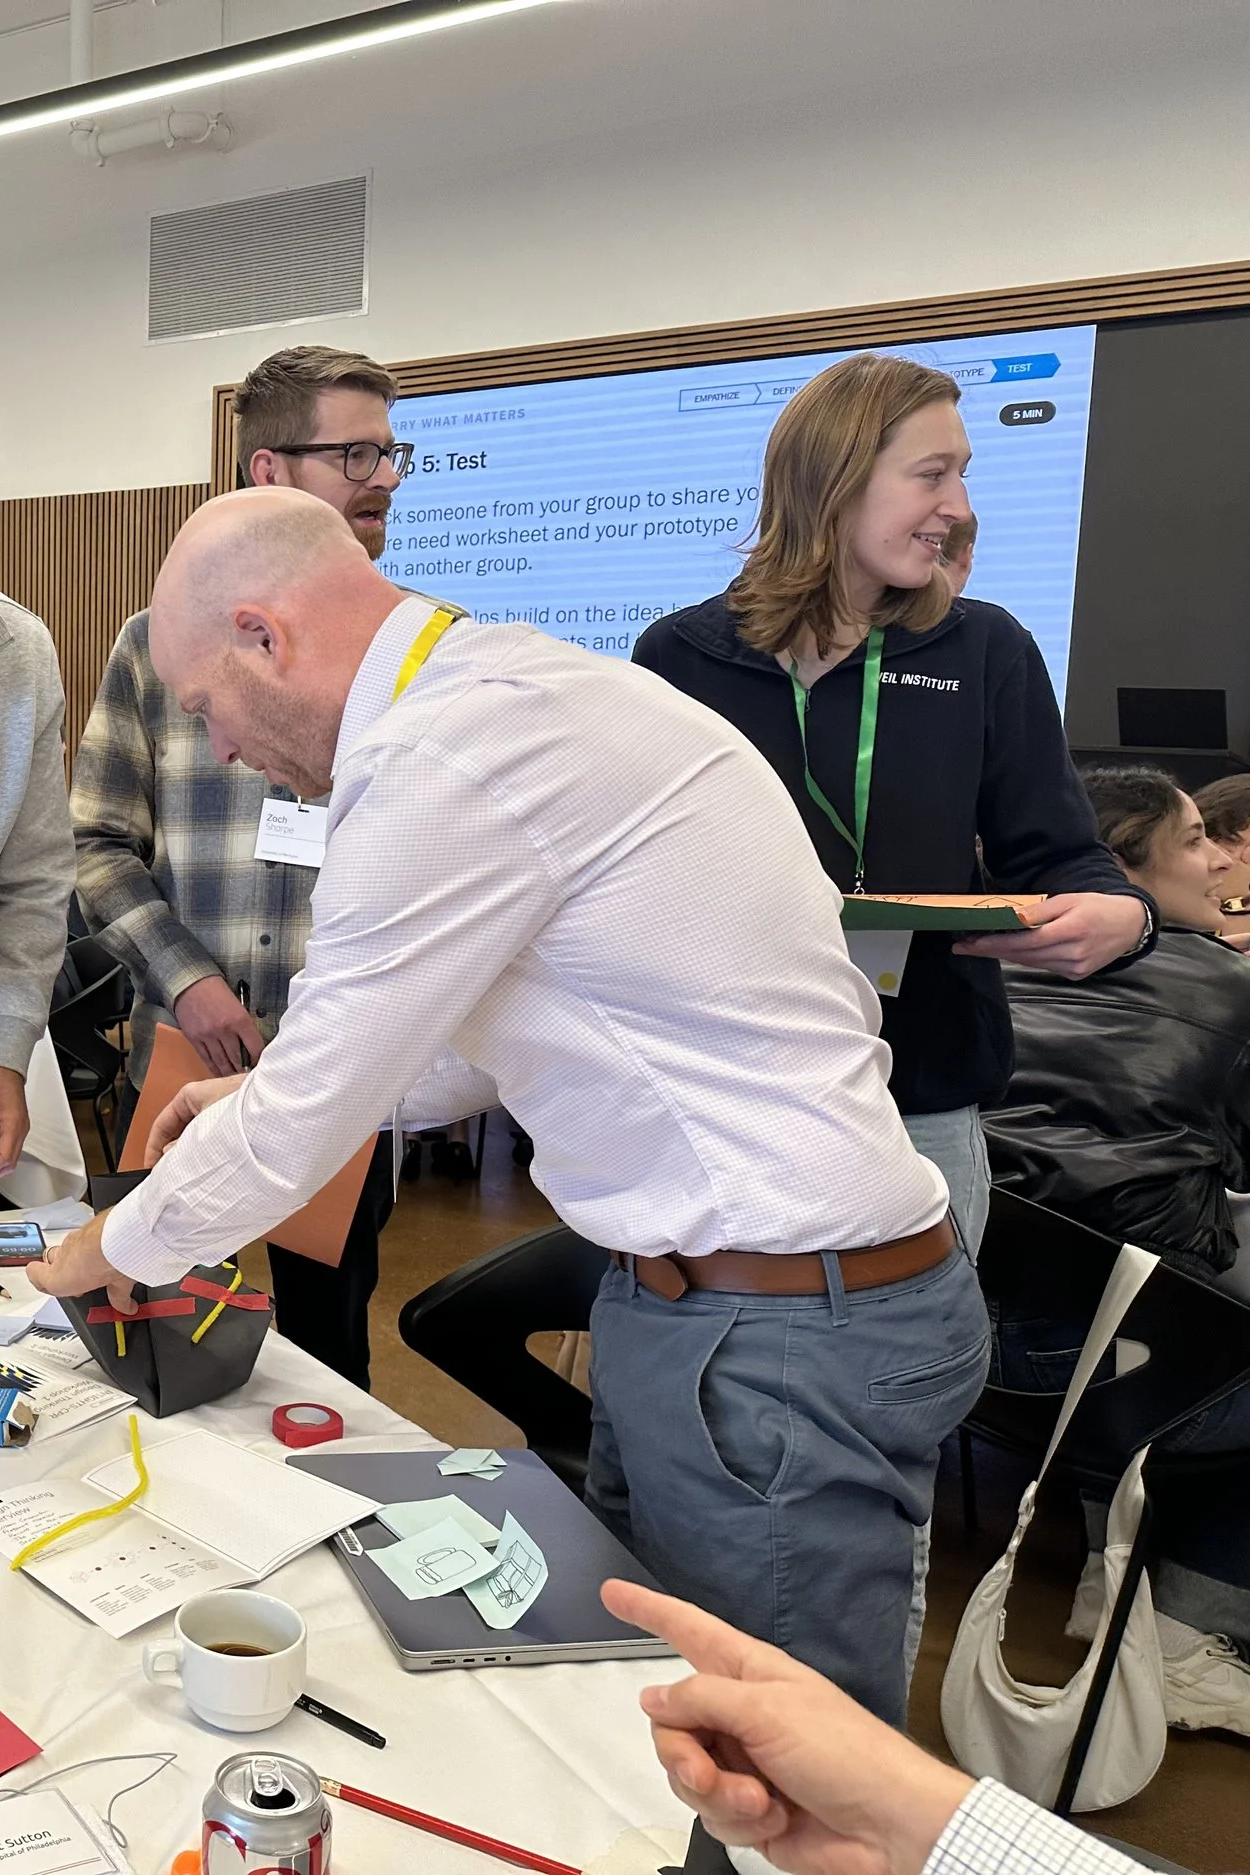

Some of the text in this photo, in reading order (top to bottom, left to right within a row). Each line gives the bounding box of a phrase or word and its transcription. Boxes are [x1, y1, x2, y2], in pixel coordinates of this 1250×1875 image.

[694, 391, 740, 403] EMPATHIZE
[1007, 363, 1033, 374] TEST
[392, 408, 526, 432] RRY WHAT MATTERS
[1012, 408, 1043, 420] 5 MIN
[422, 455, 441, 473] 5:
[446, 451, 488, 471] Test
[386, 486, 760, 525] ck someone from your group to share yo
[387, 516, 738, 551] re need worksheet and your prototype
[379, 556, 533, 577] ith another group.
[474, 609, 499, 625] lps
[505, 607, 550, 624] build
[555, 610, 579, 624] on
[585, 605, 616, 623] the
[622, 603, 664, 621] idea
[592, 632, 630, 650] and
[900, 673, 960, 691] INSTITUTE
[8, 1490, 55, 1510] Thinking
[5, 1828, 52, 1849] Sutton
[17, 1846, 26, 1857] of
[26, 1835, 72, 1855] Philadelphia
